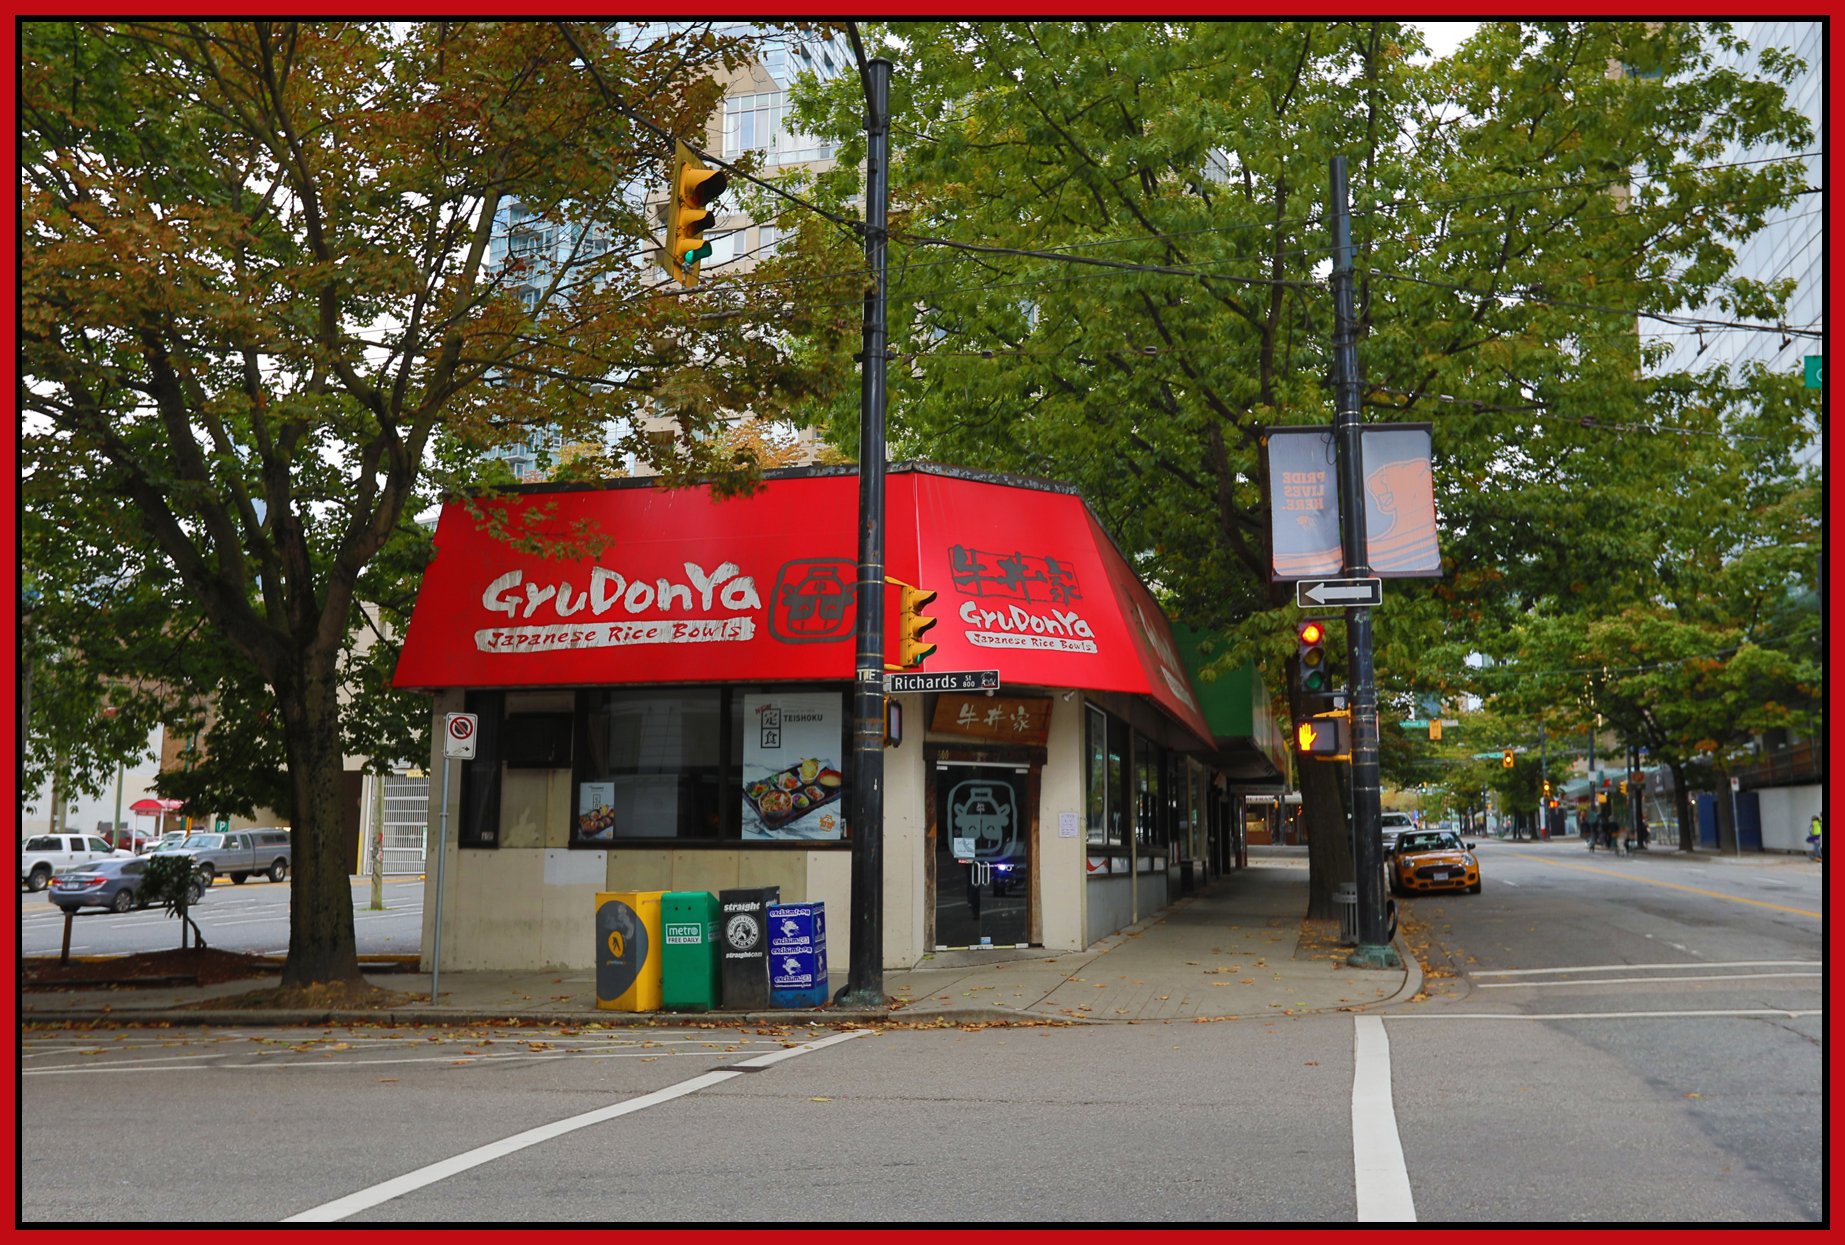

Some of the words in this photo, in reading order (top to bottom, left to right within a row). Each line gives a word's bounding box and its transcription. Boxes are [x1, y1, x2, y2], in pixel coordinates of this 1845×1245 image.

[482, 561, 762, 619] GyuDonYa
[959, 600, 1096, 639] GyuDonYa
[488, 630, 597, 648] Japanese
[608, 625, 659, 642] Rice
[672, 621, 742, 640] Bowls
[974, 633, 1026, 645] Japanese
[1032, 637, 1055, 647] Rice
[1060, 640, 1092, 651] Bowls
[894, 674, 957, 690] Richards
[783, 714, 823, 722] TEISHOKU
[723, 902, 761, 912] straight
[669, 926, 699, 936] metro
